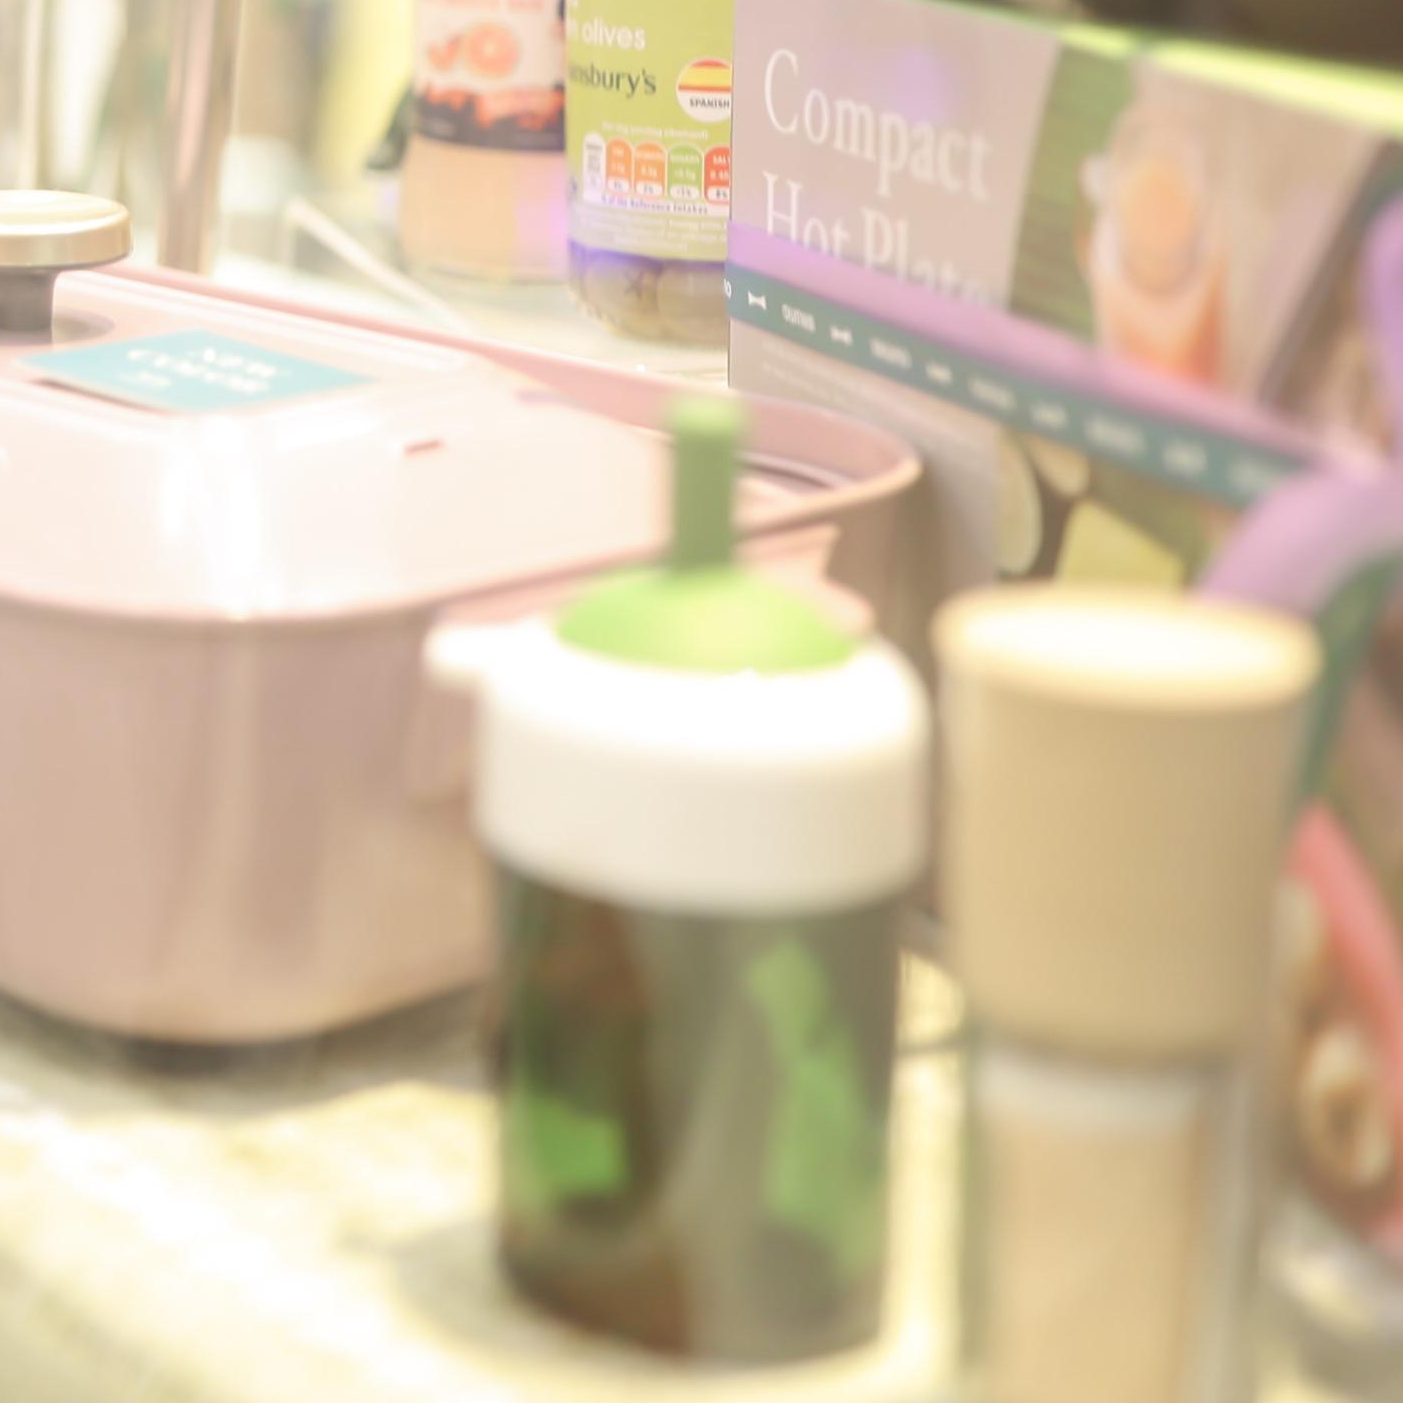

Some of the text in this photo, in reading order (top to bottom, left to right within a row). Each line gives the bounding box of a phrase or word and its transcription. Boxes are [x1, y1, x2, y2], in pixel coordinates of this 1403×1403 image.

[582, 18, 646, 51] olives
[689, 98, 730, 109] SPANISH
[764, 49, 991, 202] Compact
